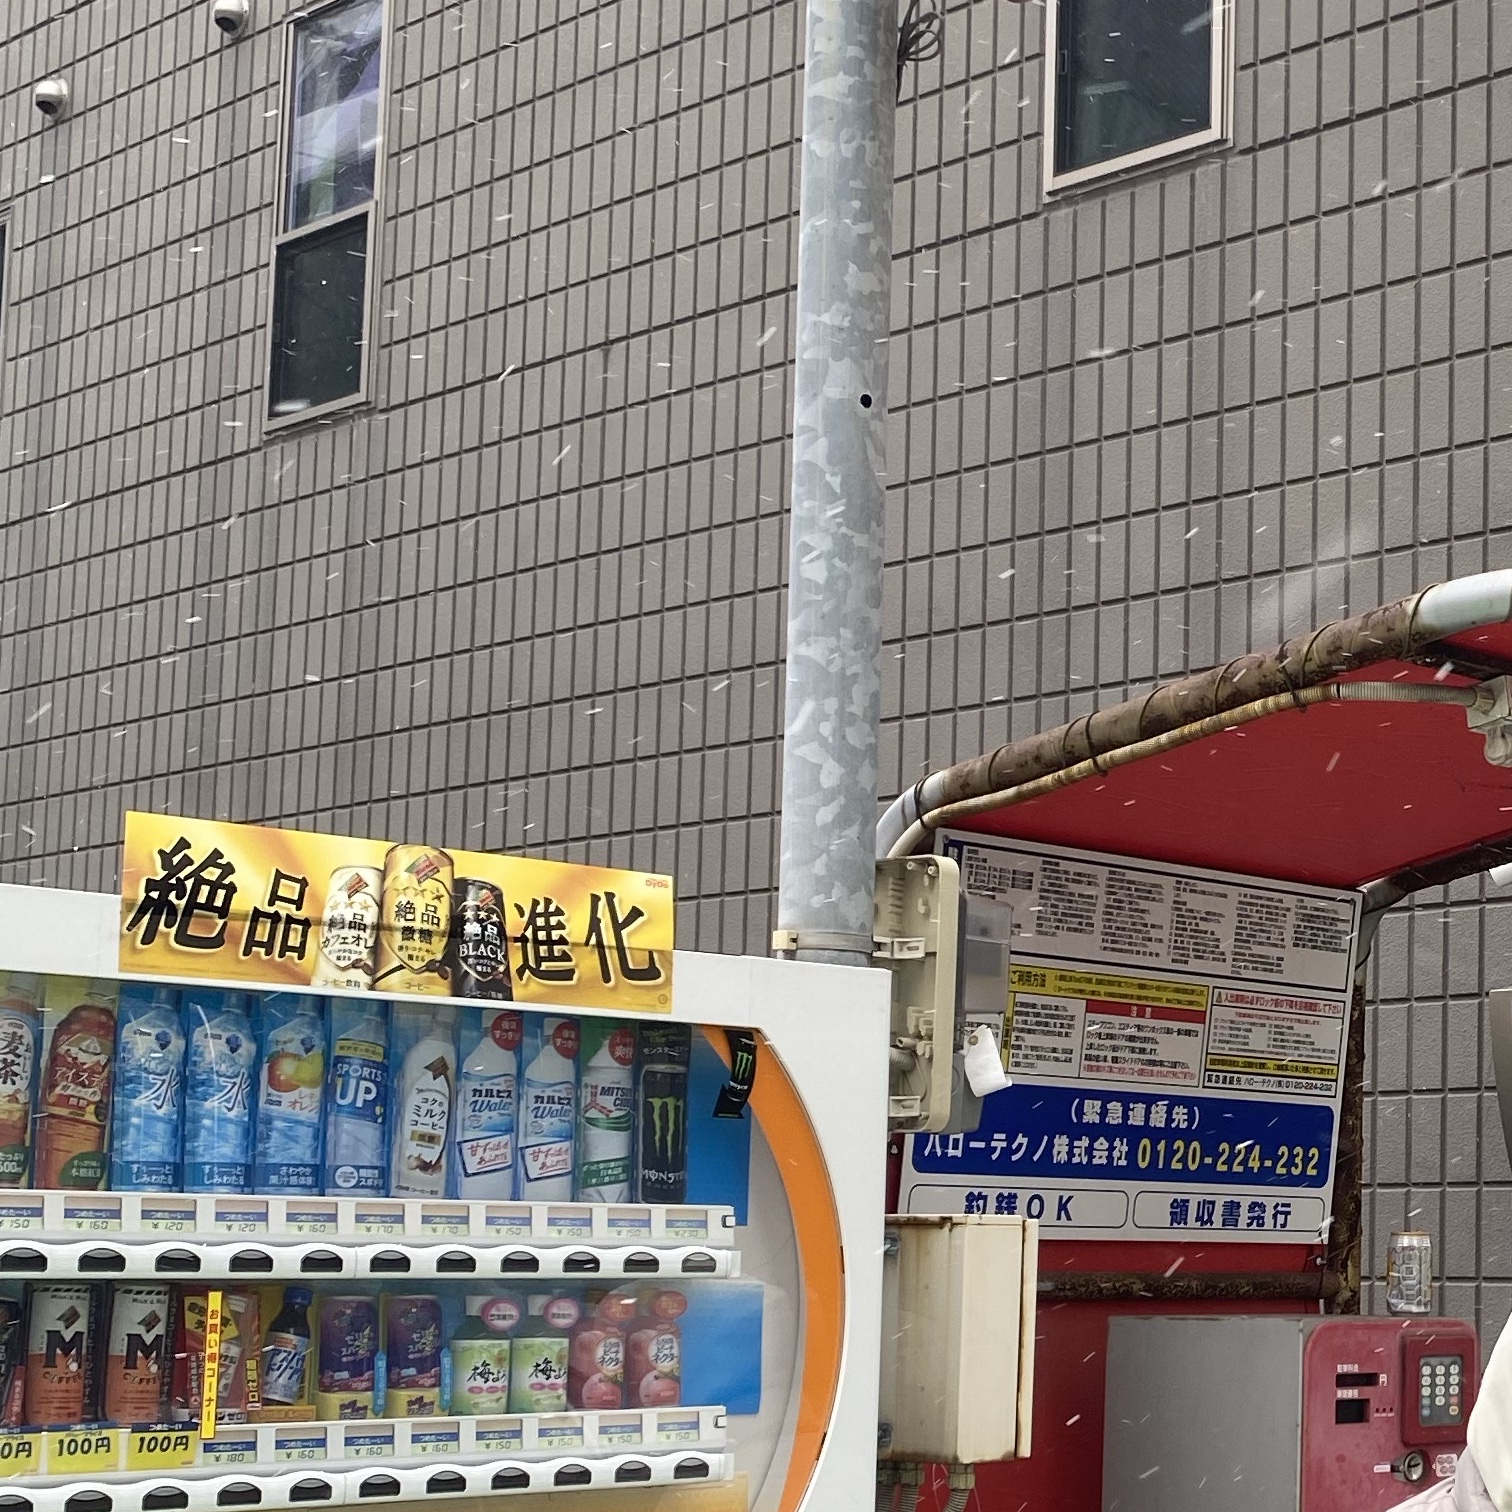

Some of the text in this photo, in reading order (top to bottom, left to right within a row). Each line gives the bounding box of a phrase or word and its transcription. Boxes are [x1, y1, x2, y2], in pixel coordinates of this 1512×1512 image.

[126, 836, 312, 961] 絶品
[394, 900, 441, 928] 絶品
[459, 943, 506, 962] BLACK
[514, 891, 662, 984] 進化
[336, 1062, 383, 1082] SPORTS
[1285, 1080, 1333, 1093] 0120-224-232
[335, 1077, 378, 1109] UP
[409, 1119, 446, 1131] コーヒー
[412, 1105, 447, 1122] ミルク
[924, 1132, 1320, 1178] ハローテクノ株式会社 0120-224-232
[1168, 1197, 1293, 1231] 領収書発行
[43, 1330, 85, 1369] M
[123, 1333, 165, 1370] M
[204, 1308, 220, 1422] お買い得コーナー
[57, 1437, 111, 1457] 100円
[137, 1434, 190, 1454] 100円
